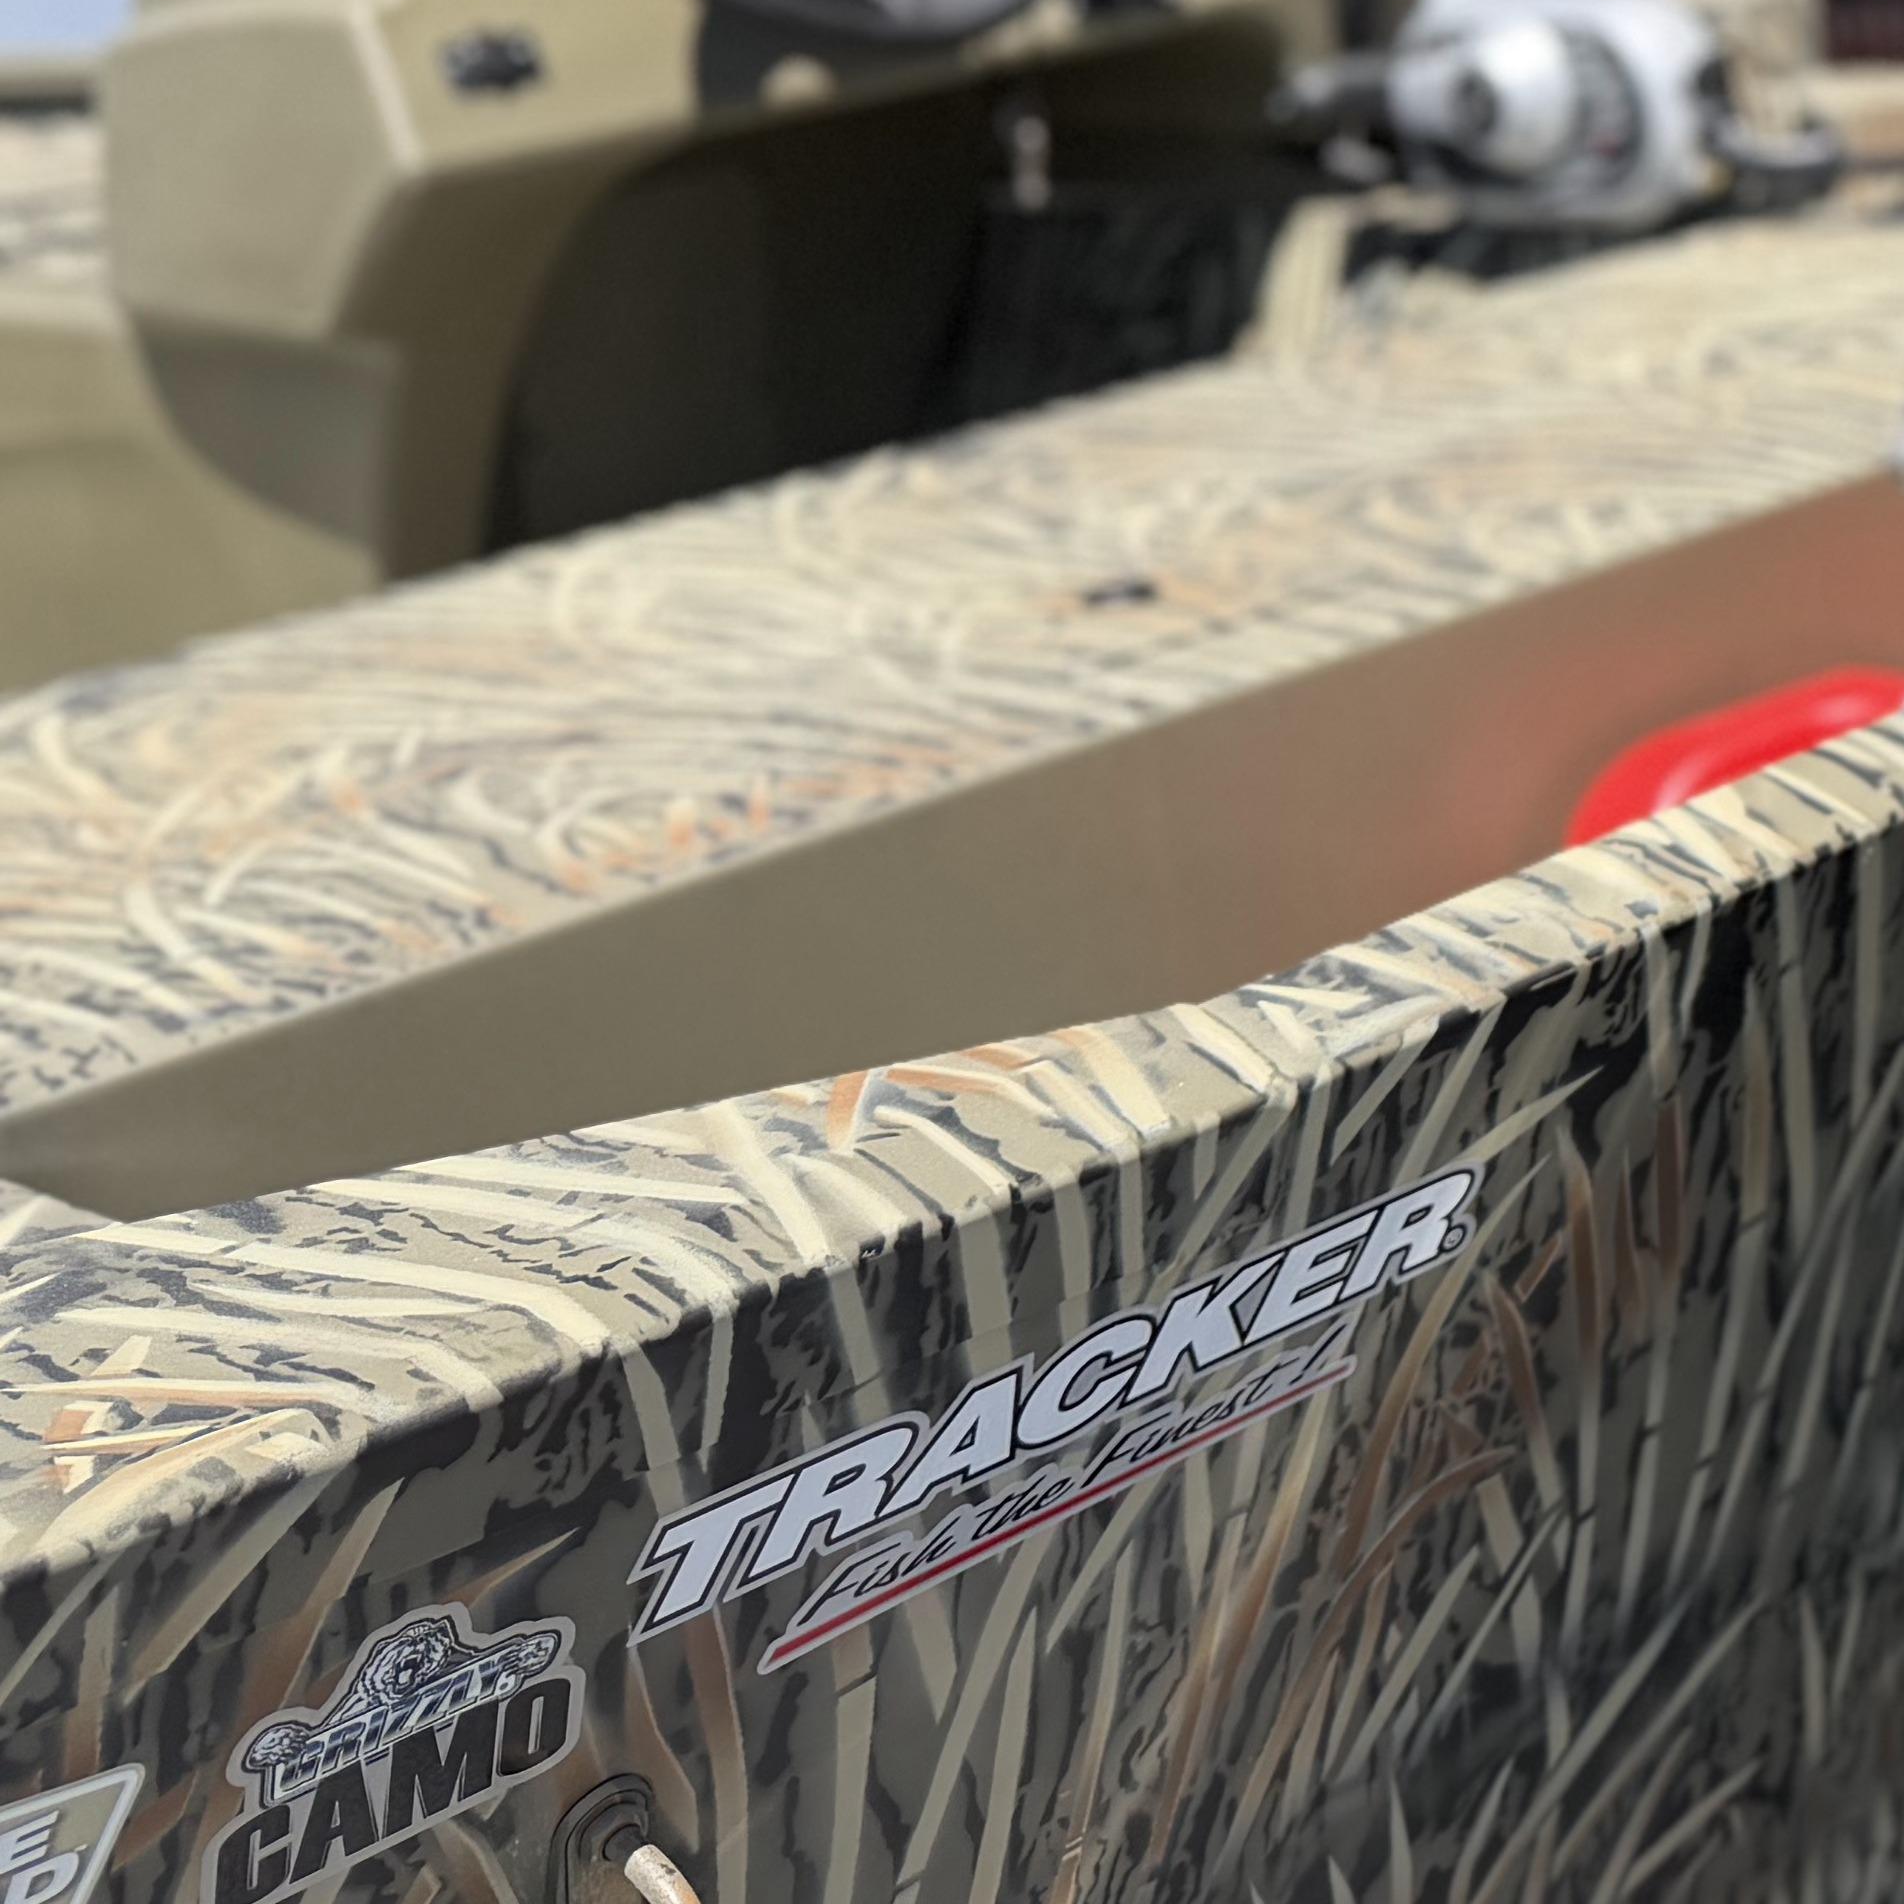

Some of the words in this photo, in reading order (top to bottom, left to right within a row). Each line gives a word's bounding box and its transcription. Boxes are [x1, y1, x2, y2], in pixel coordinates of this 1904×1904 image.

[796, 1517, 966, 1627] Fish
[971, 1474, 1076, 1539] the
[215, 1677, 572, 1904] CAMO
[276, 1656, 515, 1794] GRIZZLY
